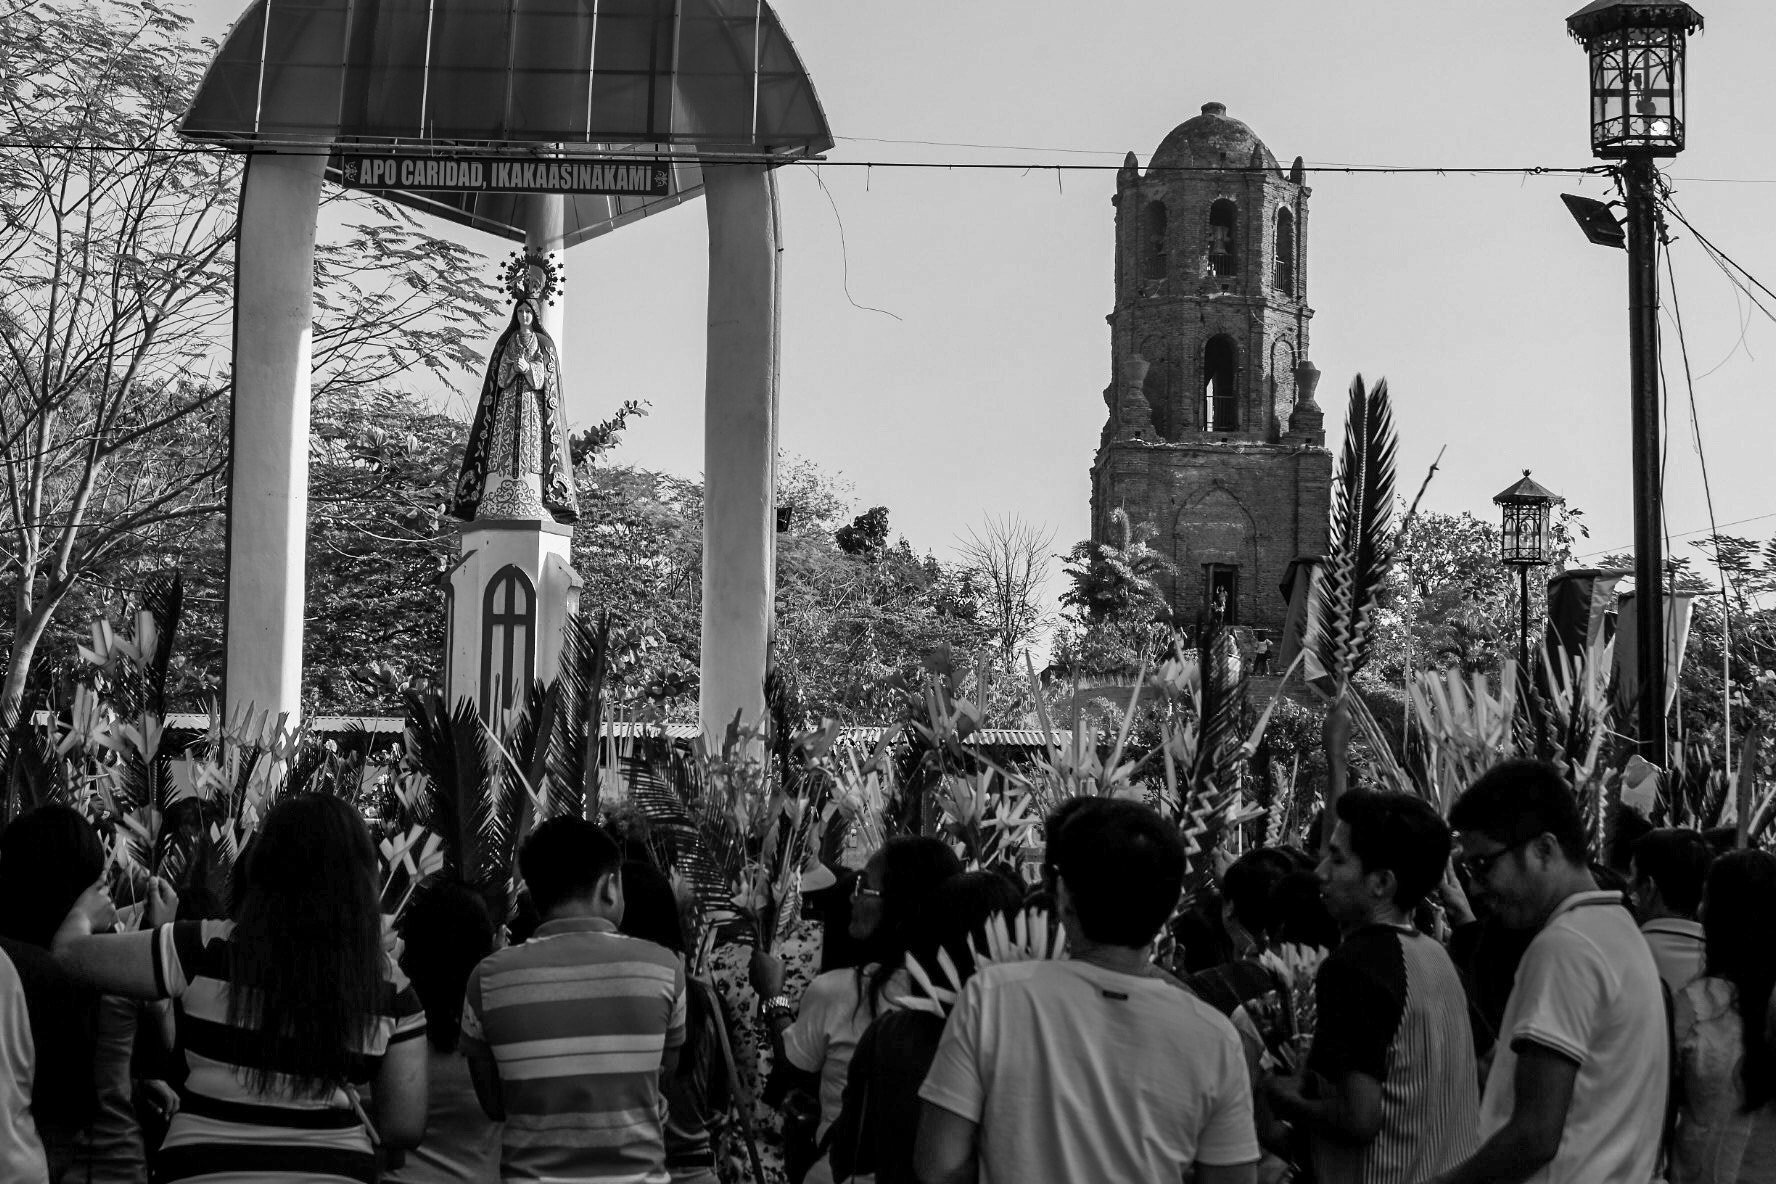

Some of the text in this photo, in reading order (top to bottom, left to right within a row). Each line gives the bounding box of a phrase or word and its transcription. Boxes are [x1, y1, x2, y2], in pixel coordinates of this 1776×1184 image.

[359, 159, 652, 191] APO CARIDAD, IKAKAASINAKAMI
